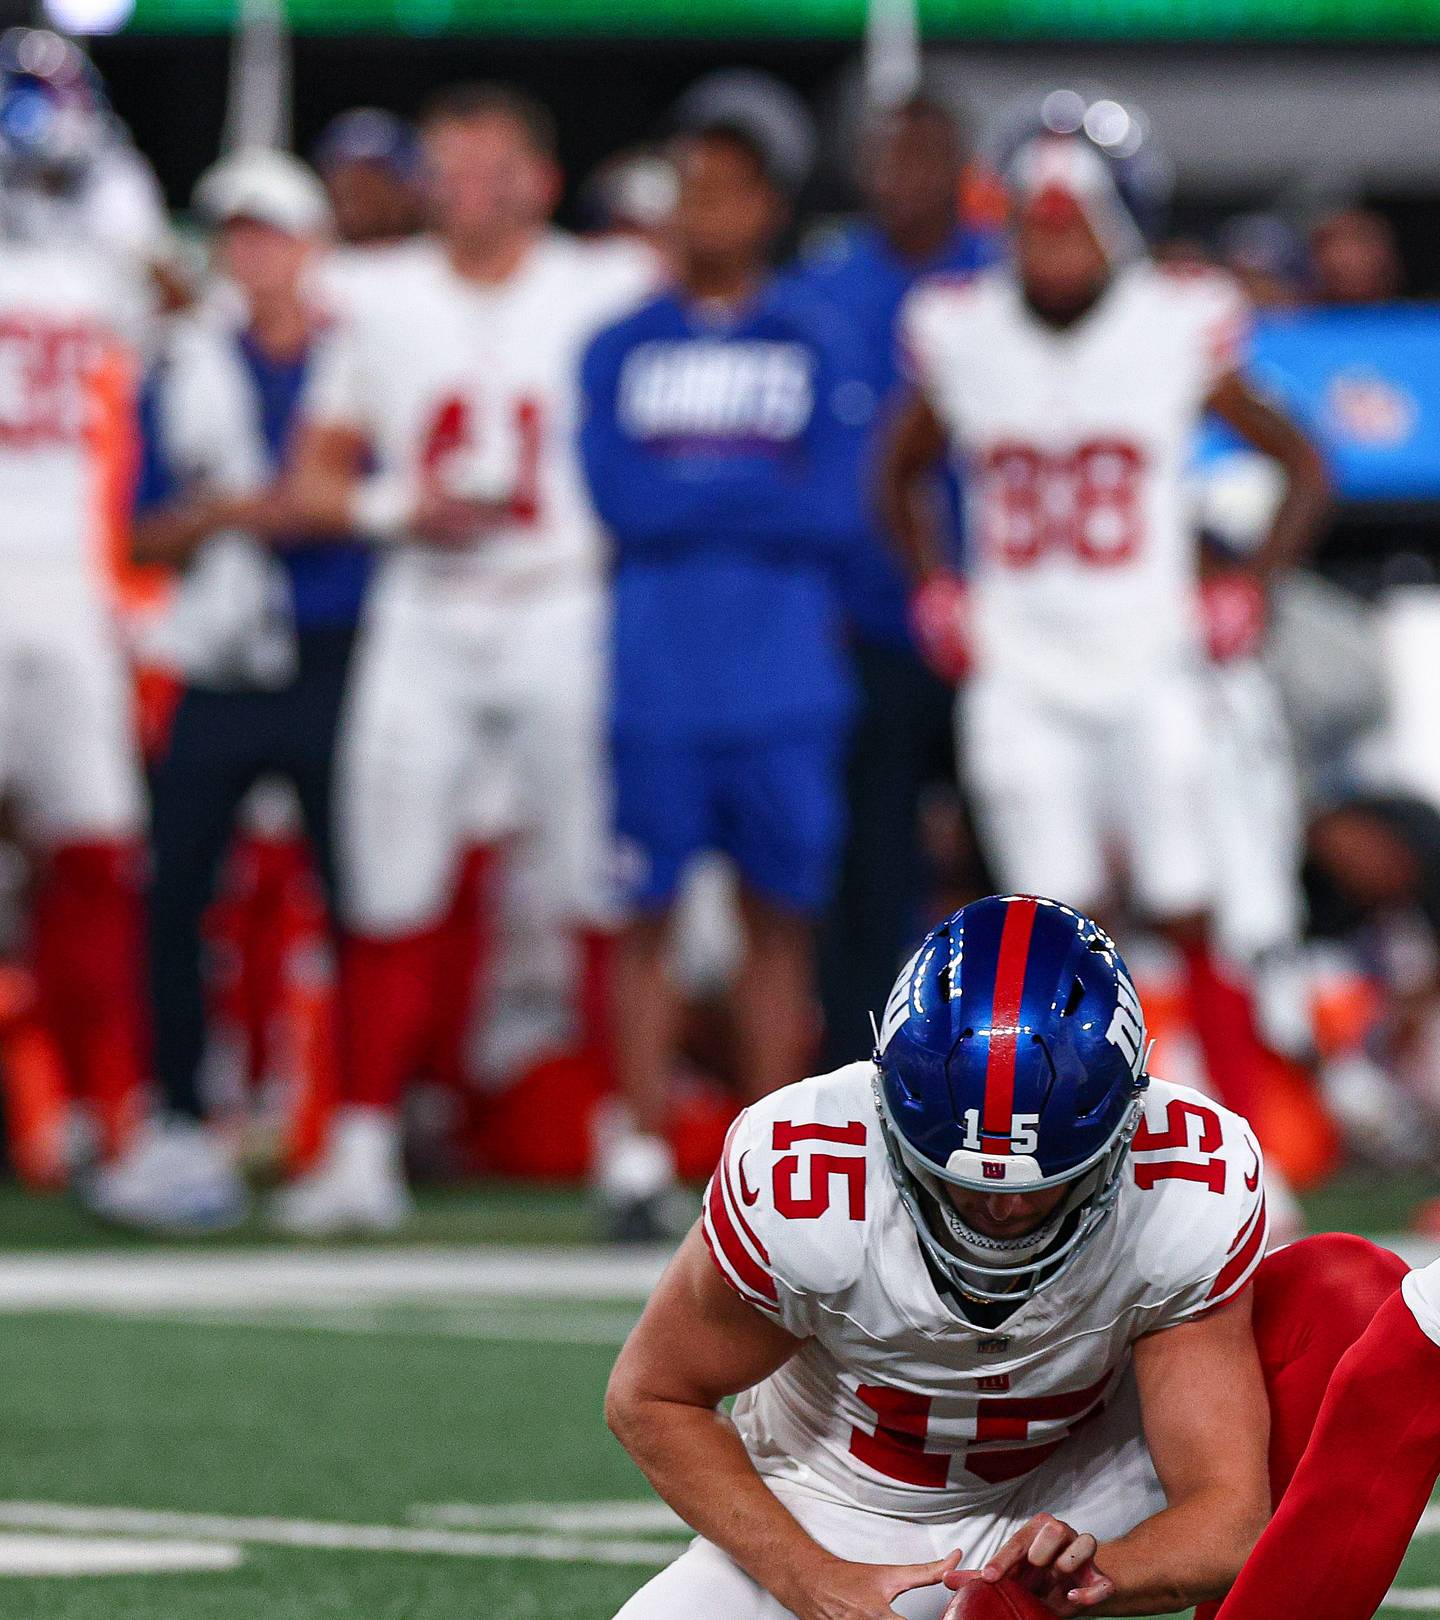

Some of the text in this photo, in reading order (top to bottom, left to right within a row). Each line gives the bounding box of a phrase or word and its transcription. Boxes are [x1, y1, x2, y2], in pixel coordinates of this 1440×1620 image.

[771, 1119, 867, 1221] 15
[962, 1108, 1040, 1154] 15
[1130, 1099, 1226, 1195] 15
[848, 1369, 1115, 1489] 15
